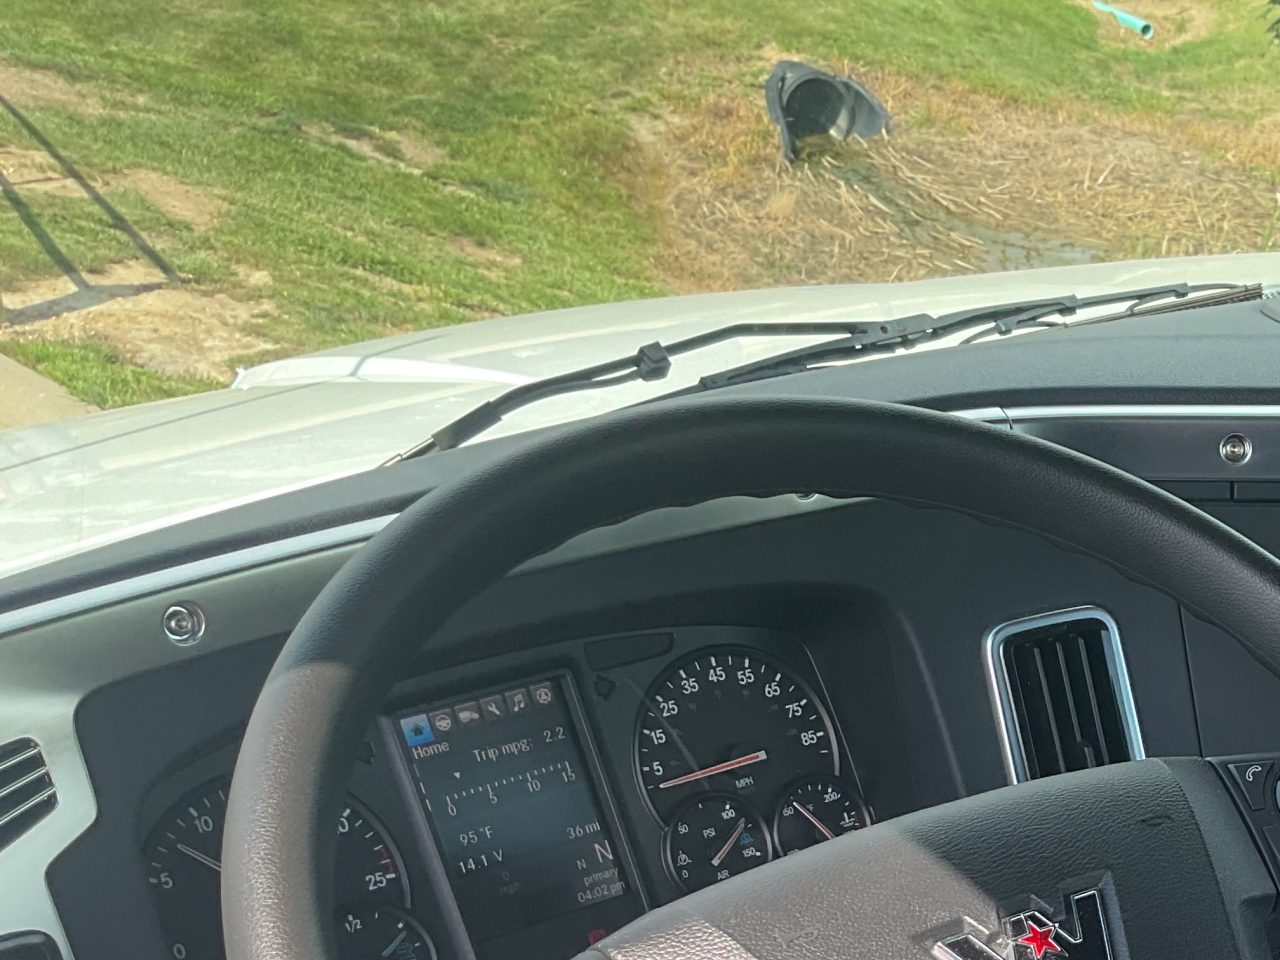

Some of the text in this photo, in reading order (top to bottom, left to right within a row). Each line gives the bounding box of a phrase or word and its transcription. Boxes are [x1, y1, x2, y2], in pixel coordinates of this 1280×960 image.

[708, 665, 727, 683] 45
[736, 668, 755, 685] 55
[681, 678, 699, 695] 35
[764, 681, 781, 698] 65
[659, 700, 679, 717] 25
[785, 702, 803, 719] 75
[473, 726, 567, 762] Trip mpg: 2.2
[650, 729, 666, 745] 15
[801, 730, 818, 746] 85
[412, 741, 450, 760] Home
[653, 761, 663, 776] 5
[528, 778, 542, 793] 10
[562, 770, 576, 783] 15
[735, 776, 754, 789] MPH
[823, 791, 838, 803] 200
[721, 809, 736, 820] 100
[194, 815, 214, 834] 10
[566, 818, 601, 840] 36 mi
[677, 824, 689, 835] 50
[702, 827, 716, 838] PSI
[459, 830, 478, 846] 95
[594, 840, 614, 863] N
[742, 847, 756, 858] 150
[459, 848, 504, 874] 14.1 V
[576, 857, 588, 870] N
[160, 872, 174, 889] 5
[365, 872, 388, 891] 25
[583, 866, 620, 887] primary
[682, 869, 689, 878] 0
[577, 880, 626, 903] 04:02 pm
[172, 942, 186, 960] 0
